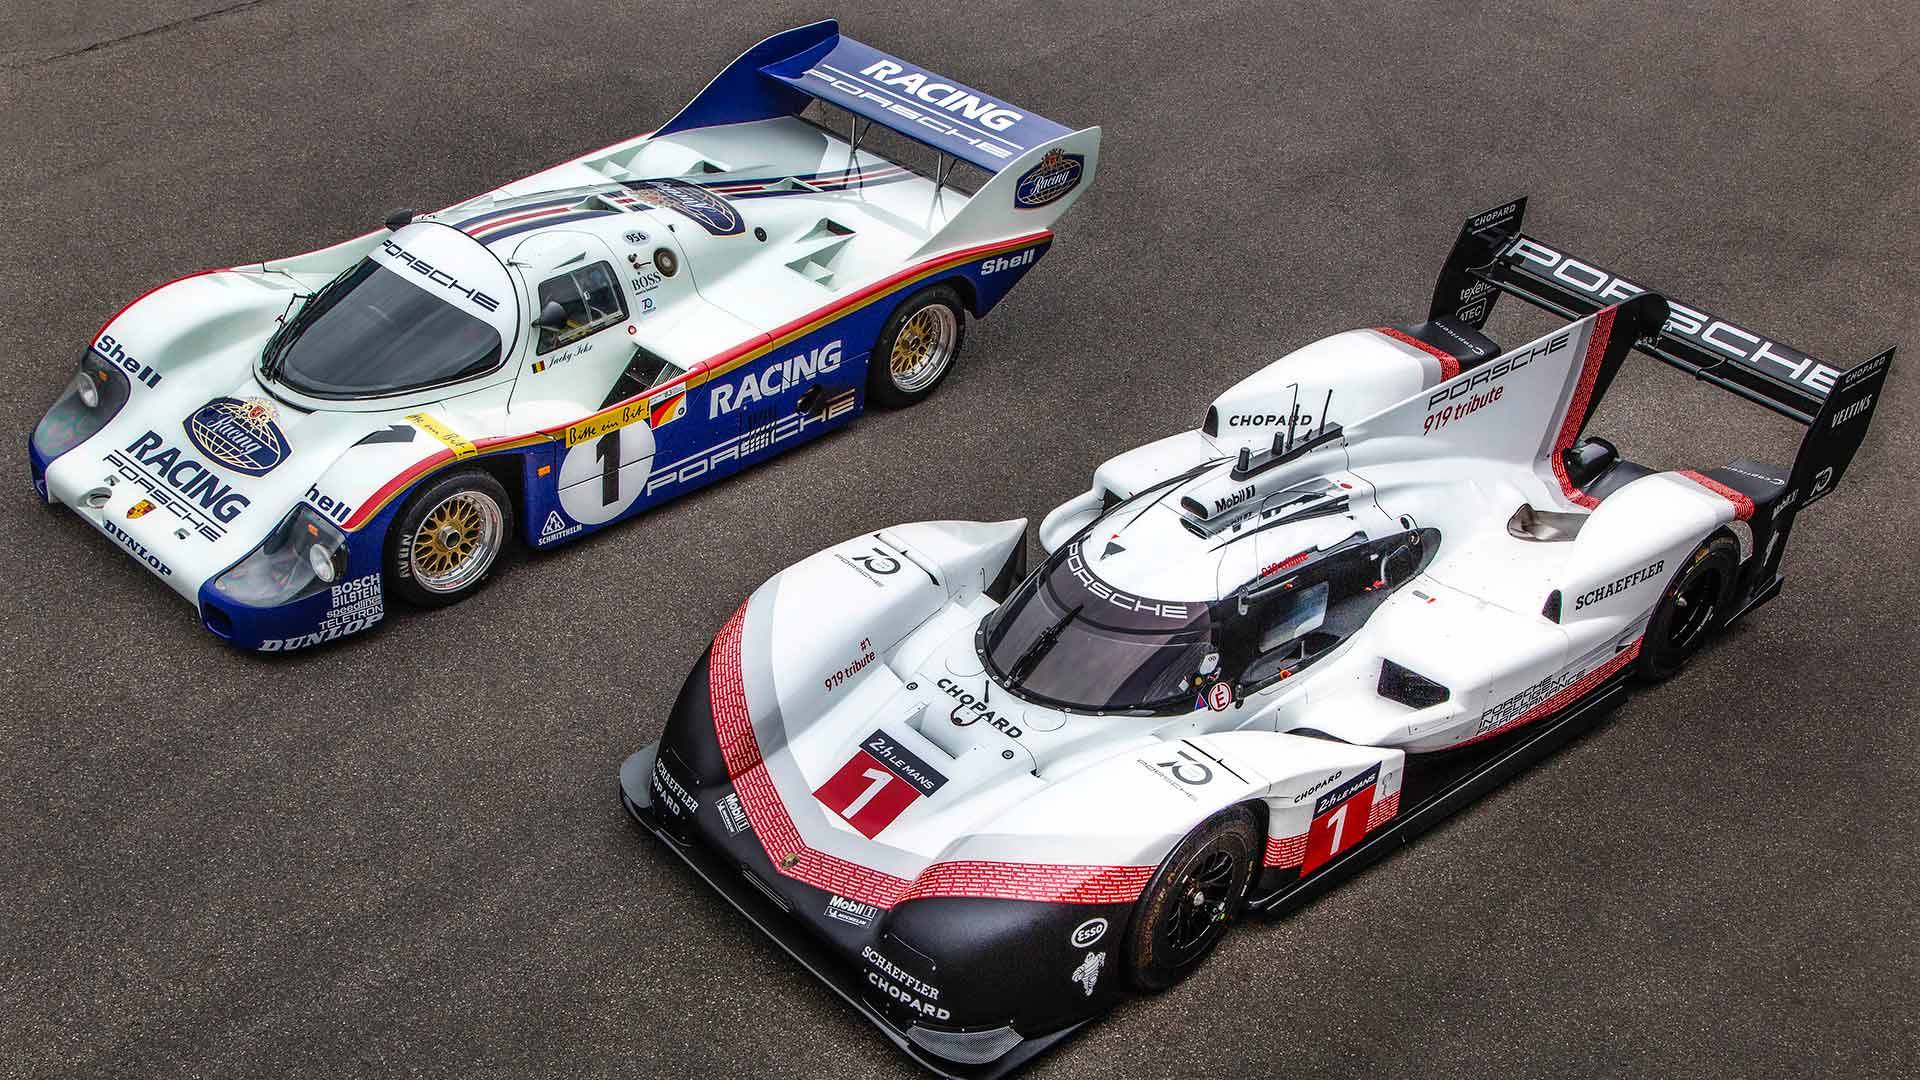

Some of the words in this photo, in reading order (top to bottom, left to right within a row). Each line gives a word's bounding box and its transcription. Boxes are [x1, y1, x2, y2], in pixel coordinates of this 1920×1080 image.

[803, 69, 1014, 159] PORSCHE
[859, 59, 1023, 132] RACING
[1030, 166, 1070, 196] Racing
[1474, 203, 1516, 227] CHOPARD
[625, 232, 647, 244] 956
[382, 239, 501, 313] PORSCHE
[631, 271, 662, 292] BOSS
[981, 249, 1035, 277] Shell
[97, 334, 163, 390] Shell
[709, 340, 842, 420] RACING
[1428, 332, 1570, 411] PORSCHE
[1845, 356, 1886, 384] CHOPARD
[1228, 414, 1313, 427] CHOPARD
[1423, 405, 1452, 436] 919
[1453, 384, 1504, 421] tribute
[1831, 393, 1873, 429] VELTINS
[208, 416, 263, 455] Racing
[569, 426, 597, 445] Bitte
[601, 420, 619, 430] ein
[124, 430, 251, 525] RACING
[595, 430, 621, 507] 1
[103, 454, 222, 543] PORSCHE
[304, 483, 352, 524] hell
[1214, 486, 1246, 513] Mobil
[104, 519, 172, 577] DUNLOP
[331, 573, 380, 597] BOSCH
[332, 583, 381, 608] BILSTEIN
[1067, 542, 1188, 620] PORSCHE
[1575, 559, 1665, 611] SCHAEFFLER
[257, 612, 385, 652] DUNLOP
[319, 604, 383, 630] TELETRON
[860, 637, 872, 651] #1
[824, 670, 845, 691] 919
[844, 650, 876, 680] tribute
[936, 678, 1023, 739] CHOPARD
[1215, 691, 1226, 708] E
[656, 757, 699, 813] SCHAEFFLER
[889, 754, 905, 768] LE
[901, 765, 935, 791] MANS
[1294, 771, 1342, 804] CHOPARD
[725, 792, 747, 822] Mobil
[840, 767, 895, 820] 1
[1326, 803, 1348, 857] 1
[829, 895, 866, 915] Mobil
[1076, 924, 1104, 942] Esso
[861, 945, 940, 1001] SCHAEFFLER
[868, 971, 951, 1021] CHOPARD
